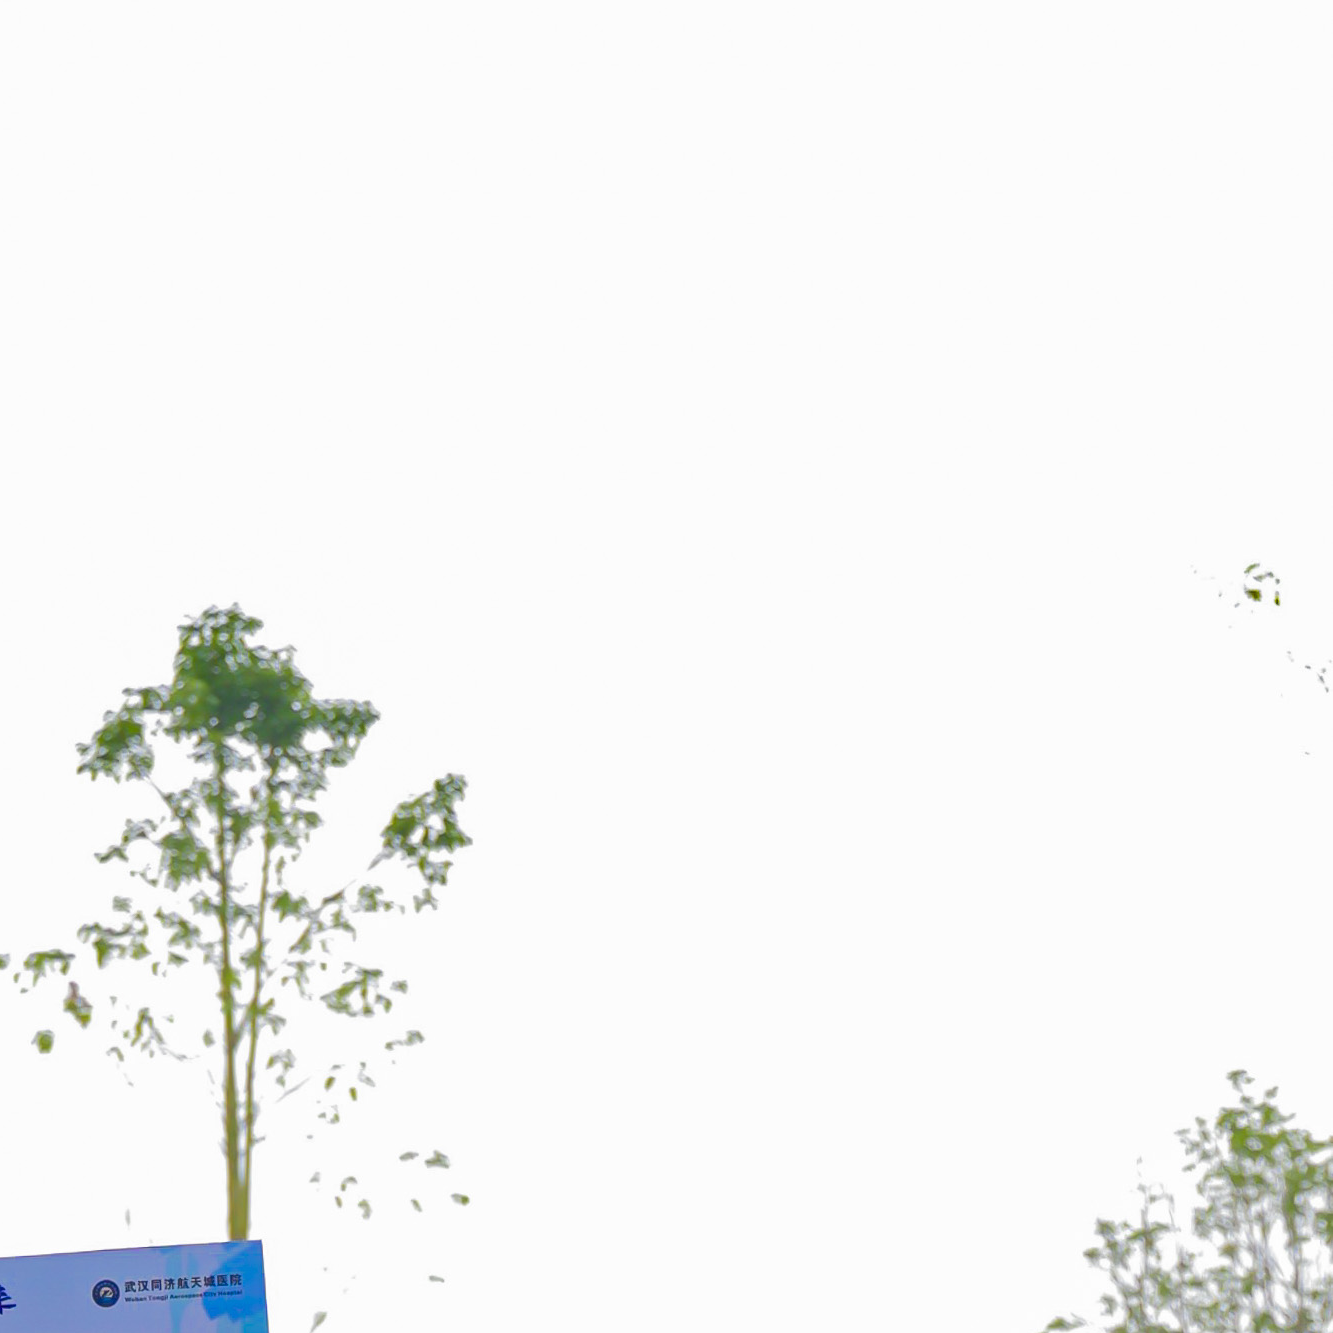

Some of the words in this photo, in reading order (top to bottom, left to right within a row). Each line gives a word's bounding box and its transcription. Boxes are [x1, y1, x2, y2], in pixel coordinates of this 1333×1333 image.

[124, 1273, 242, 1293] 武汉同济航天城医院
